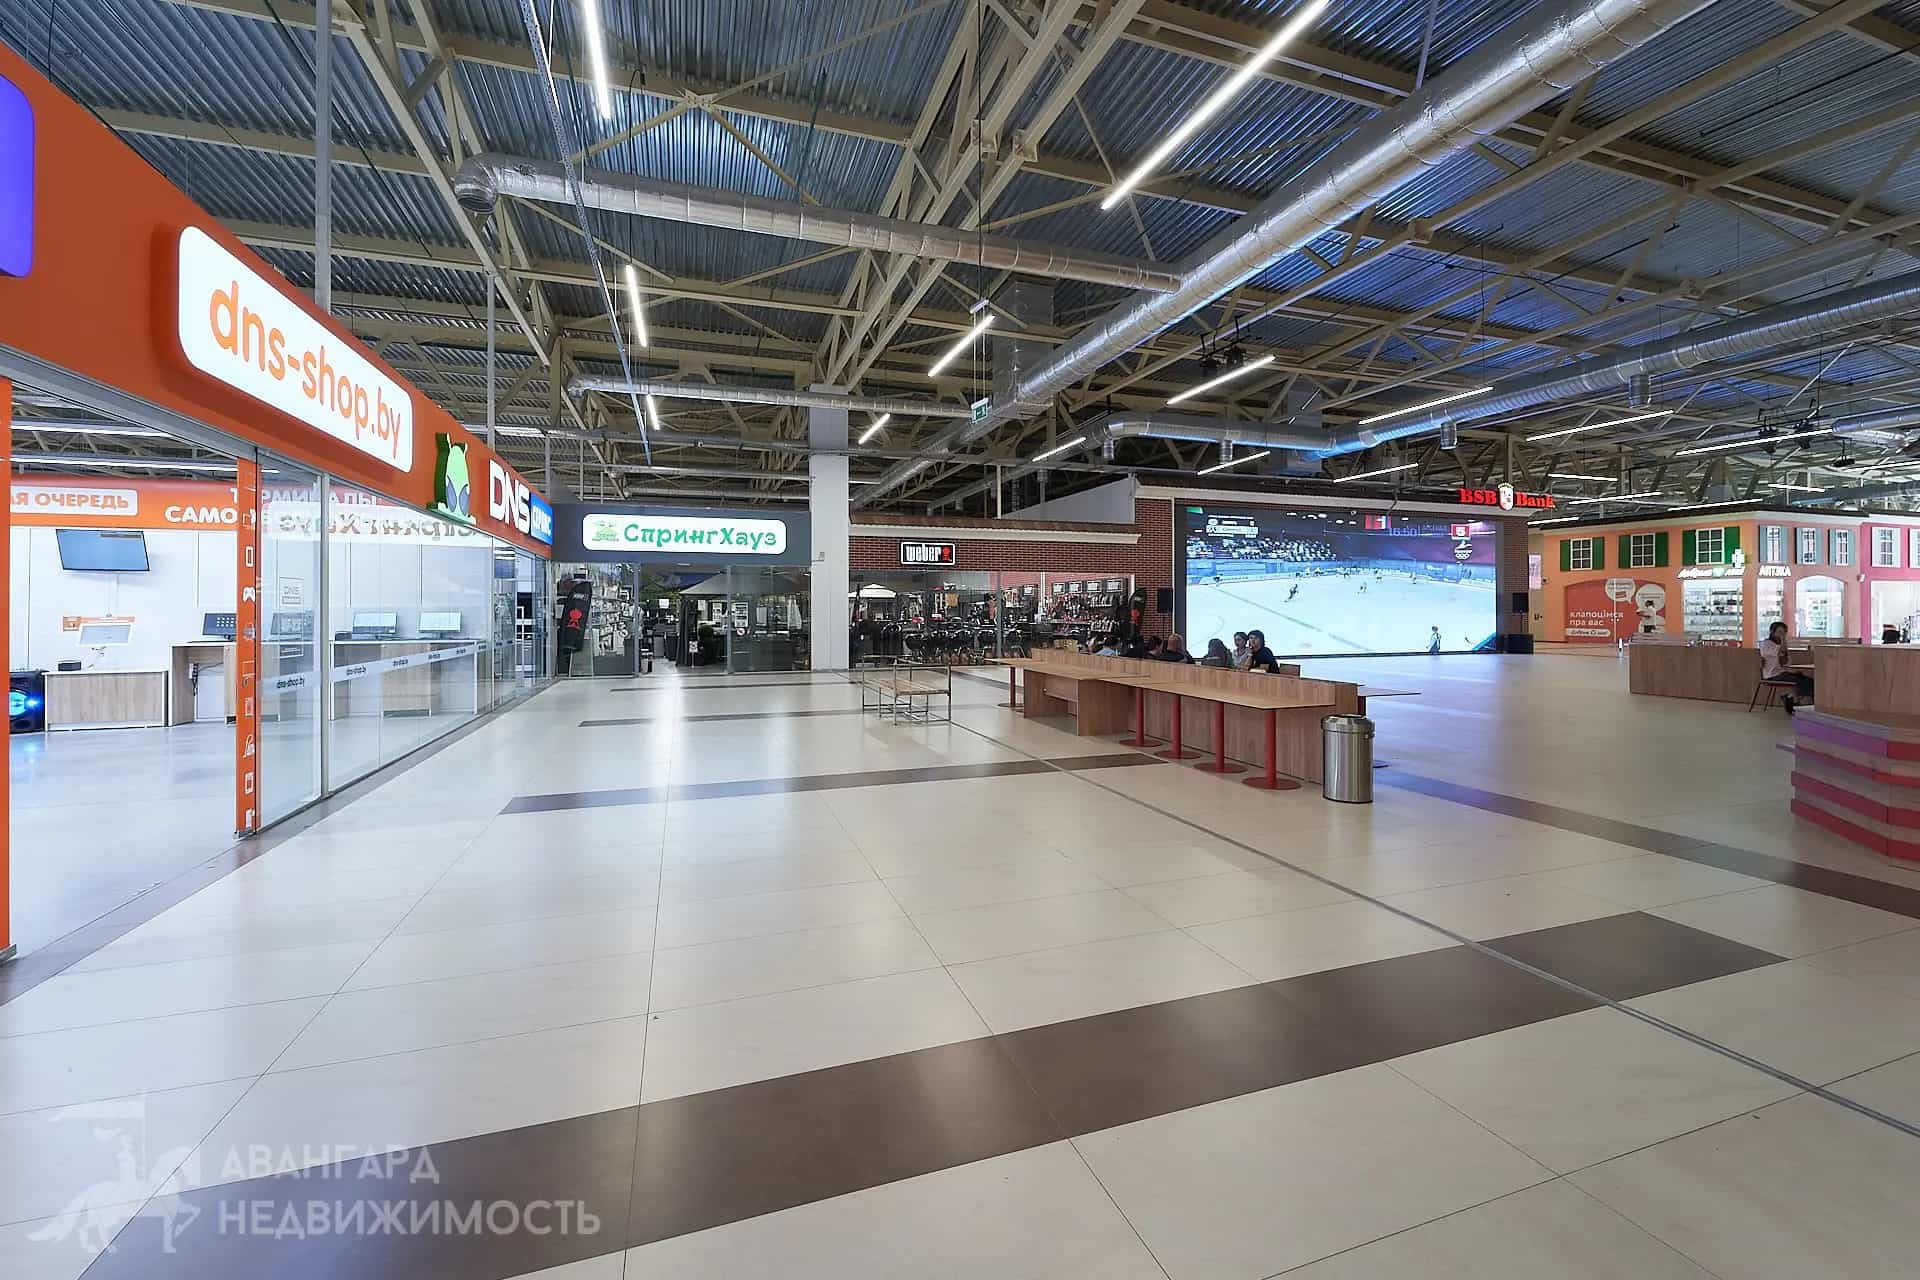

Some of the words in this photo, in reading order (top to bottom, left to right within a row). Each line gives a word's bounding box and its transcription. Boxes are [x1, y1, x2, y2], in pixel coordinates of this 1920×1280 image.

[209, 280, 401, 459] dns-shop.by
[11, 491, 28, 506] Я
[34, 492, 129, 509] ОЧЕРЕДЬ
[489, 459, 531, 534] DNS
[1458, 488, 1497, 505] BSB
[1515, 491, 1556, 508] Bank
[164, 506, 238, 524] САМО
[623, 523, 777, 551] СпрингХауз
[905, 543, 942, 562] weber
